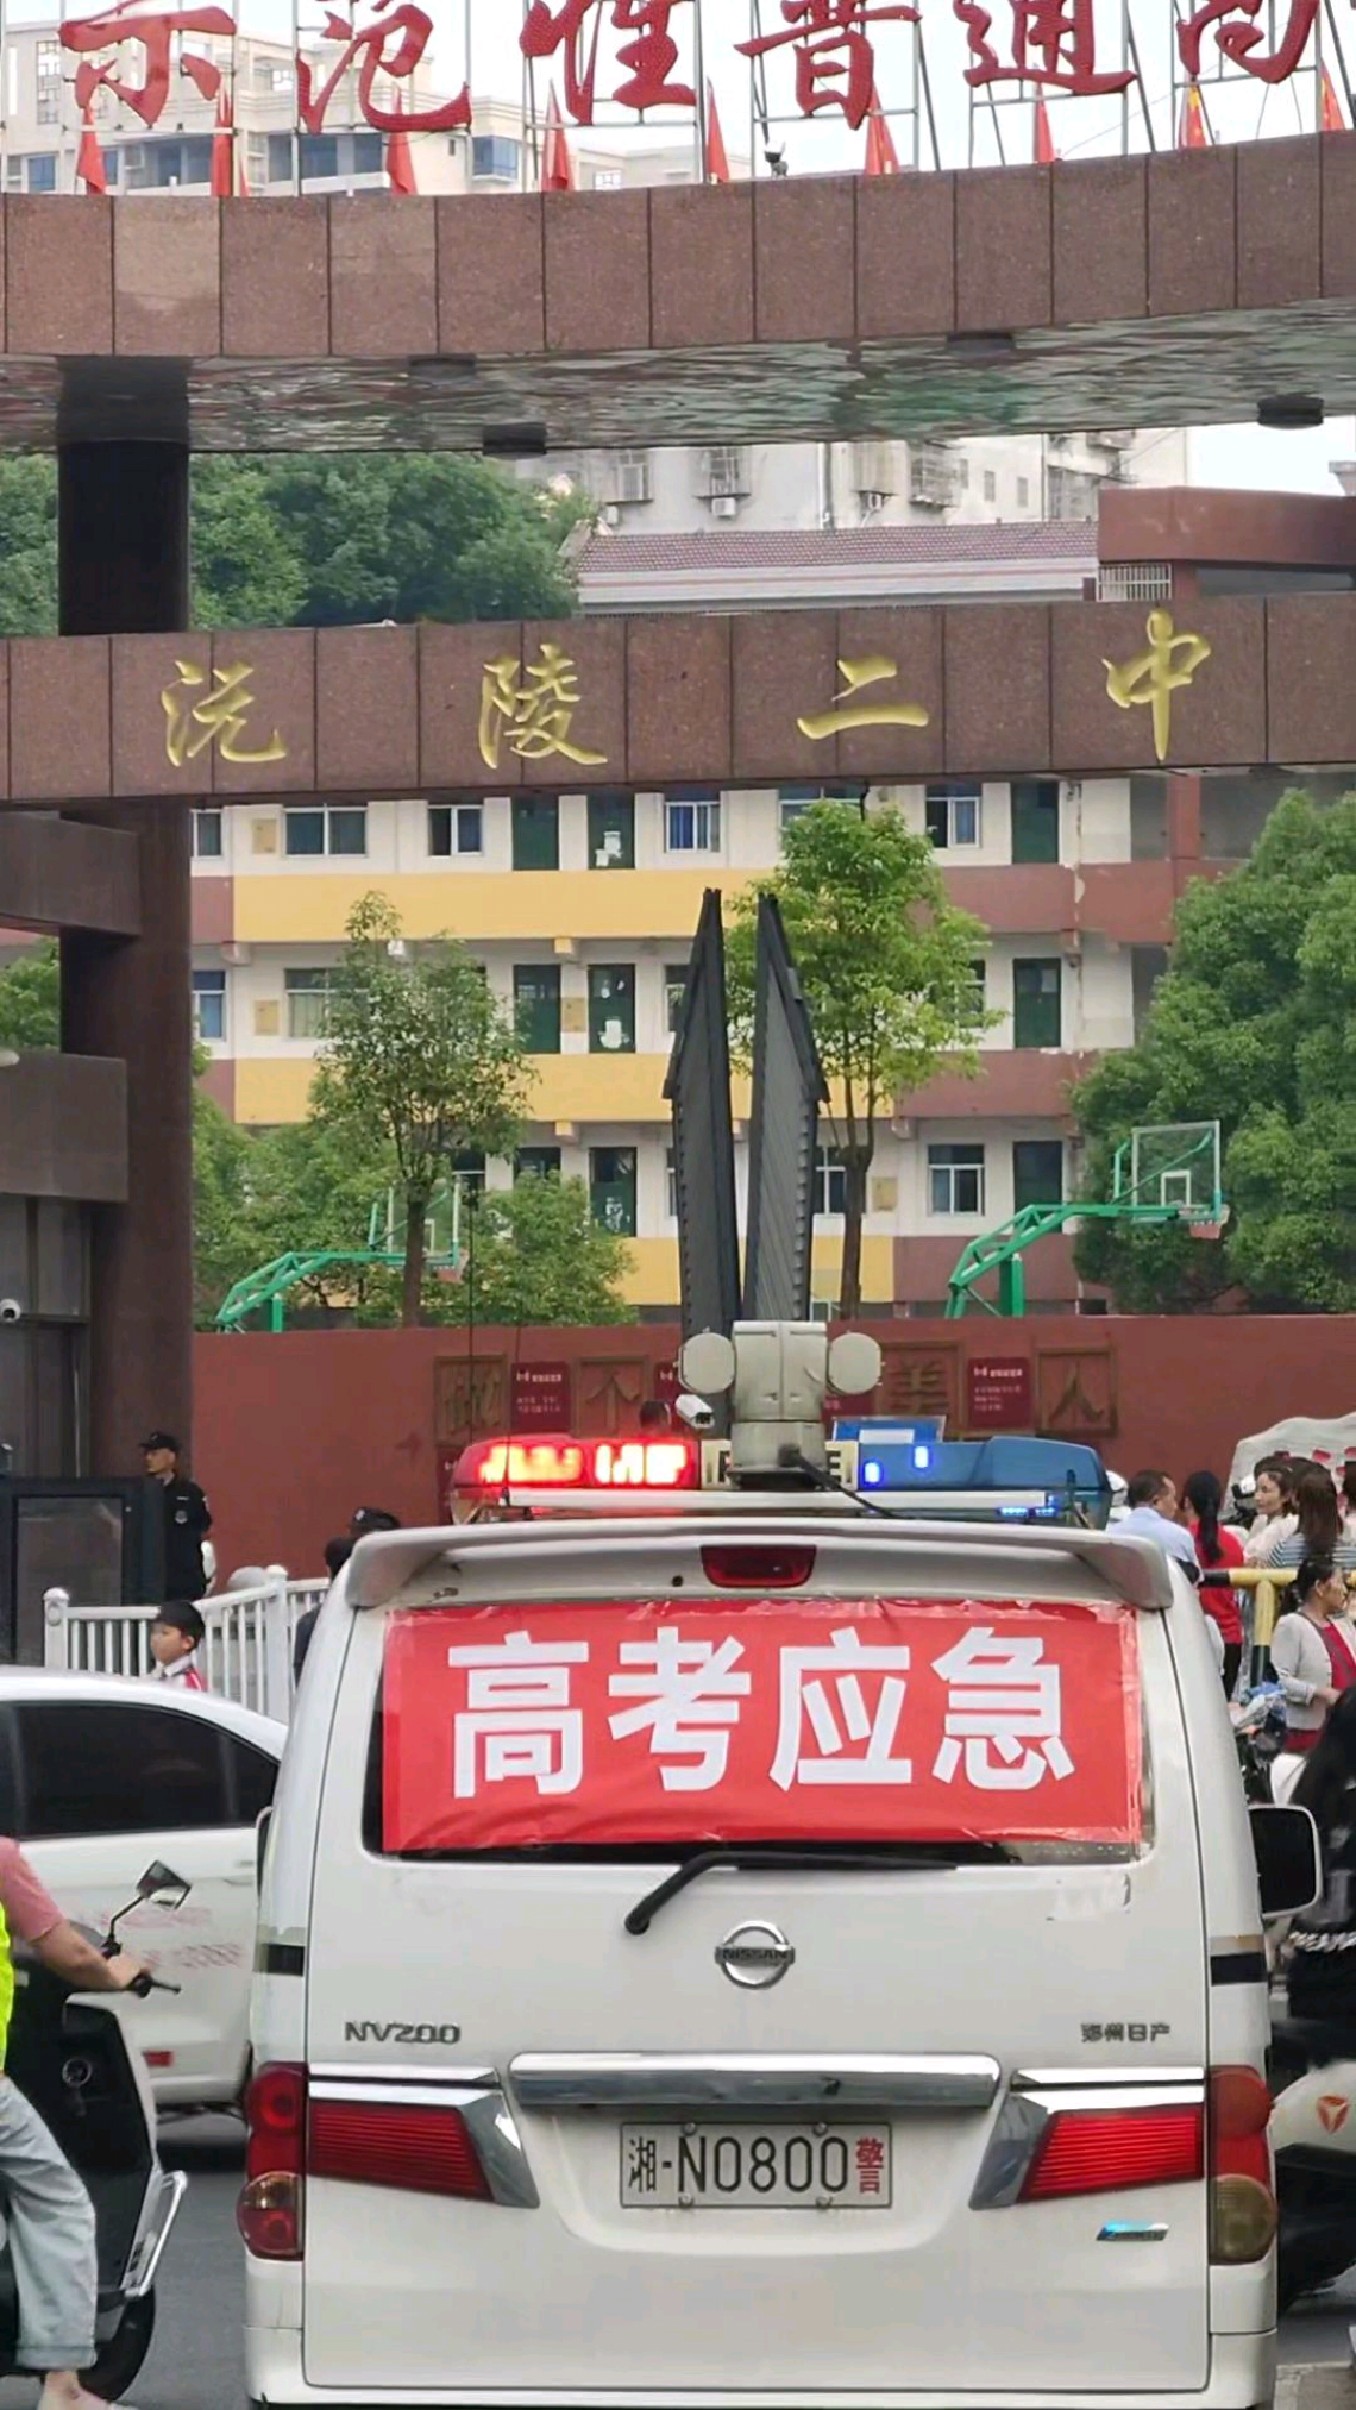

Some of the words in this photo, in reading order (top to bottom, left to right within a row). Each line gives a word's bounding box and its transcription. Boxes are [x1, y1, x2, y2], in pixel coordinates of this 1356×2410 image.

[163, 612, 1212, 763] 沅陵二中
[447, 1626, 1076, 1799] 高考应急
[345, 2021, 461, 2044] NV200
[1081, 2022, 1170, 2042] 郑州日产
